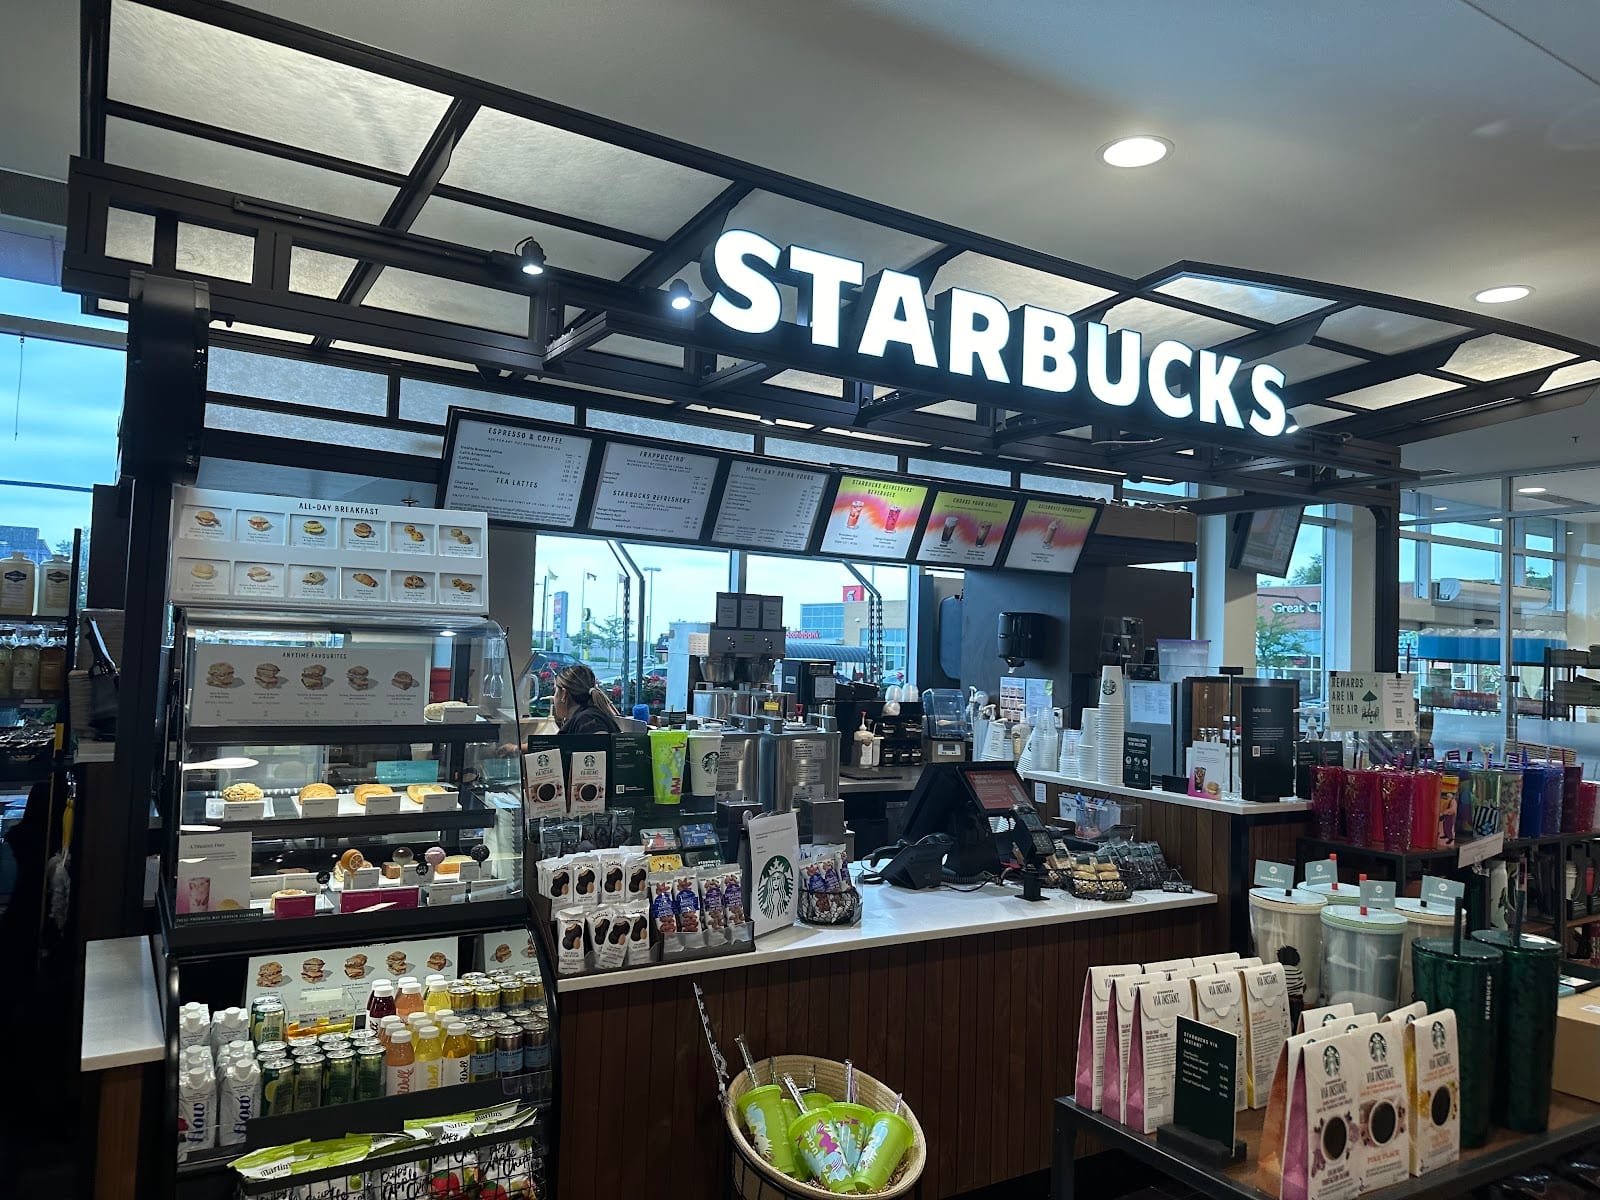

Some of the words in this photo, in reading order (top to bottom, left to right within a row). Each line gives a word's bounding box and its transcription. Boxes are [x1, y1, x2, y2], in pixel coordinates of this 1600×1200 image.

[709, 229, 1286, 437] STARBUCKS
[488, 427, 526, 439] ESPRESSO
[537, 434, 563, 445] COFFEE
[496, 477, 509, 485] TEA
[512, 479, 538, 488] LATTES
[613, 490, 650, 500] STARBUCKS
[299, 502, 331, 512] ALL-DAY
[334, 506, 379, 515] BREAKFAST
[1271, 602, 1305, 613] Great
[282, 651, 309, 659] ANYTIME
[311, 652, 347, 660] FAVOURITES
[1331, 677, 1364, 688] REWARDS
[1332, 690, 1344, 701] ARE
[1347, 691, 1354, 701] IN
[1332, 704, 1344, 714] THE
[1346, 705, 1358, 714] AIR
[1256, 976, 1264, 986] VIA
[1264, 974, 1278, 985] INSTANT
[1208, 985, 1216, 995] VIA
[1216, 983, 1232, 994] INSTANT
[1153, 995, 1162, 1007] VIA
[1162, 992, 1180, 1006] INSTANT
[1184, 1031, 1209, 1045] STARBUCKS
[1209, 1041, 1218, 1049] VIA
[1366, 1072, 1375, 1083] VIA
[1375, 1066, 1395, 1082] INSTANT
[1320, 1087, 1329, 1100] VIA
[1328, 1080, 1347, 1099] INSTANT
[187, 1102, 205, 1142] flow
